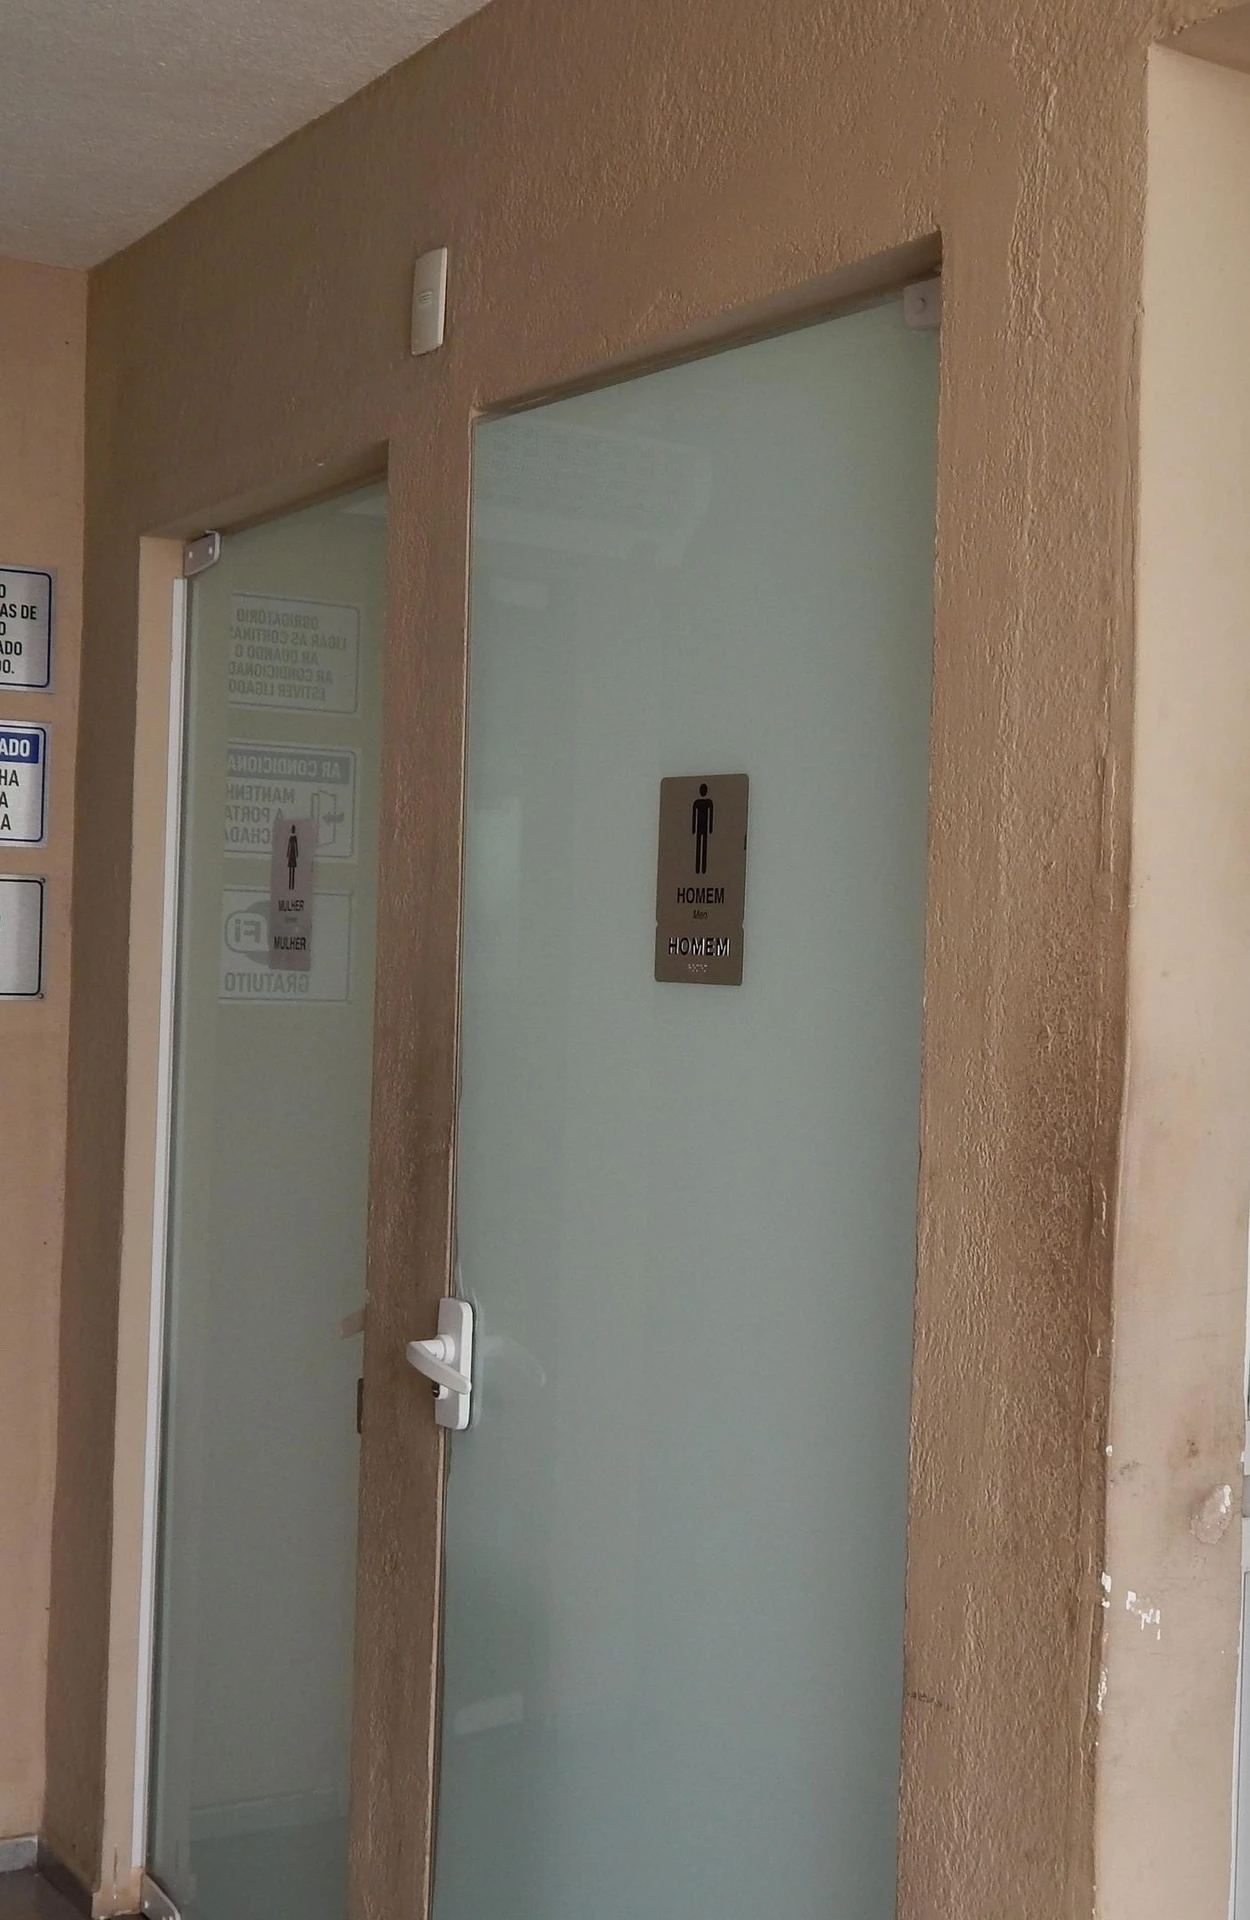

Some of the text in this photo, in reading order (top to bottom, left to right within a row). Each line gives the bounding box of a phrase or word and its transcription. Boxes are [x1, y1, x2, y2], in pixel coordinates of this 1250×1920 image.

[21, 604, 37, 620] DE
[0, 659, 14, 674] O.
[677, 887, 725, 904] HOMEM
[278, 900, 305, 912] MULHER
[273, 936, 307, 951] MULHER
[668, 937, 731, 957] HOMEM
